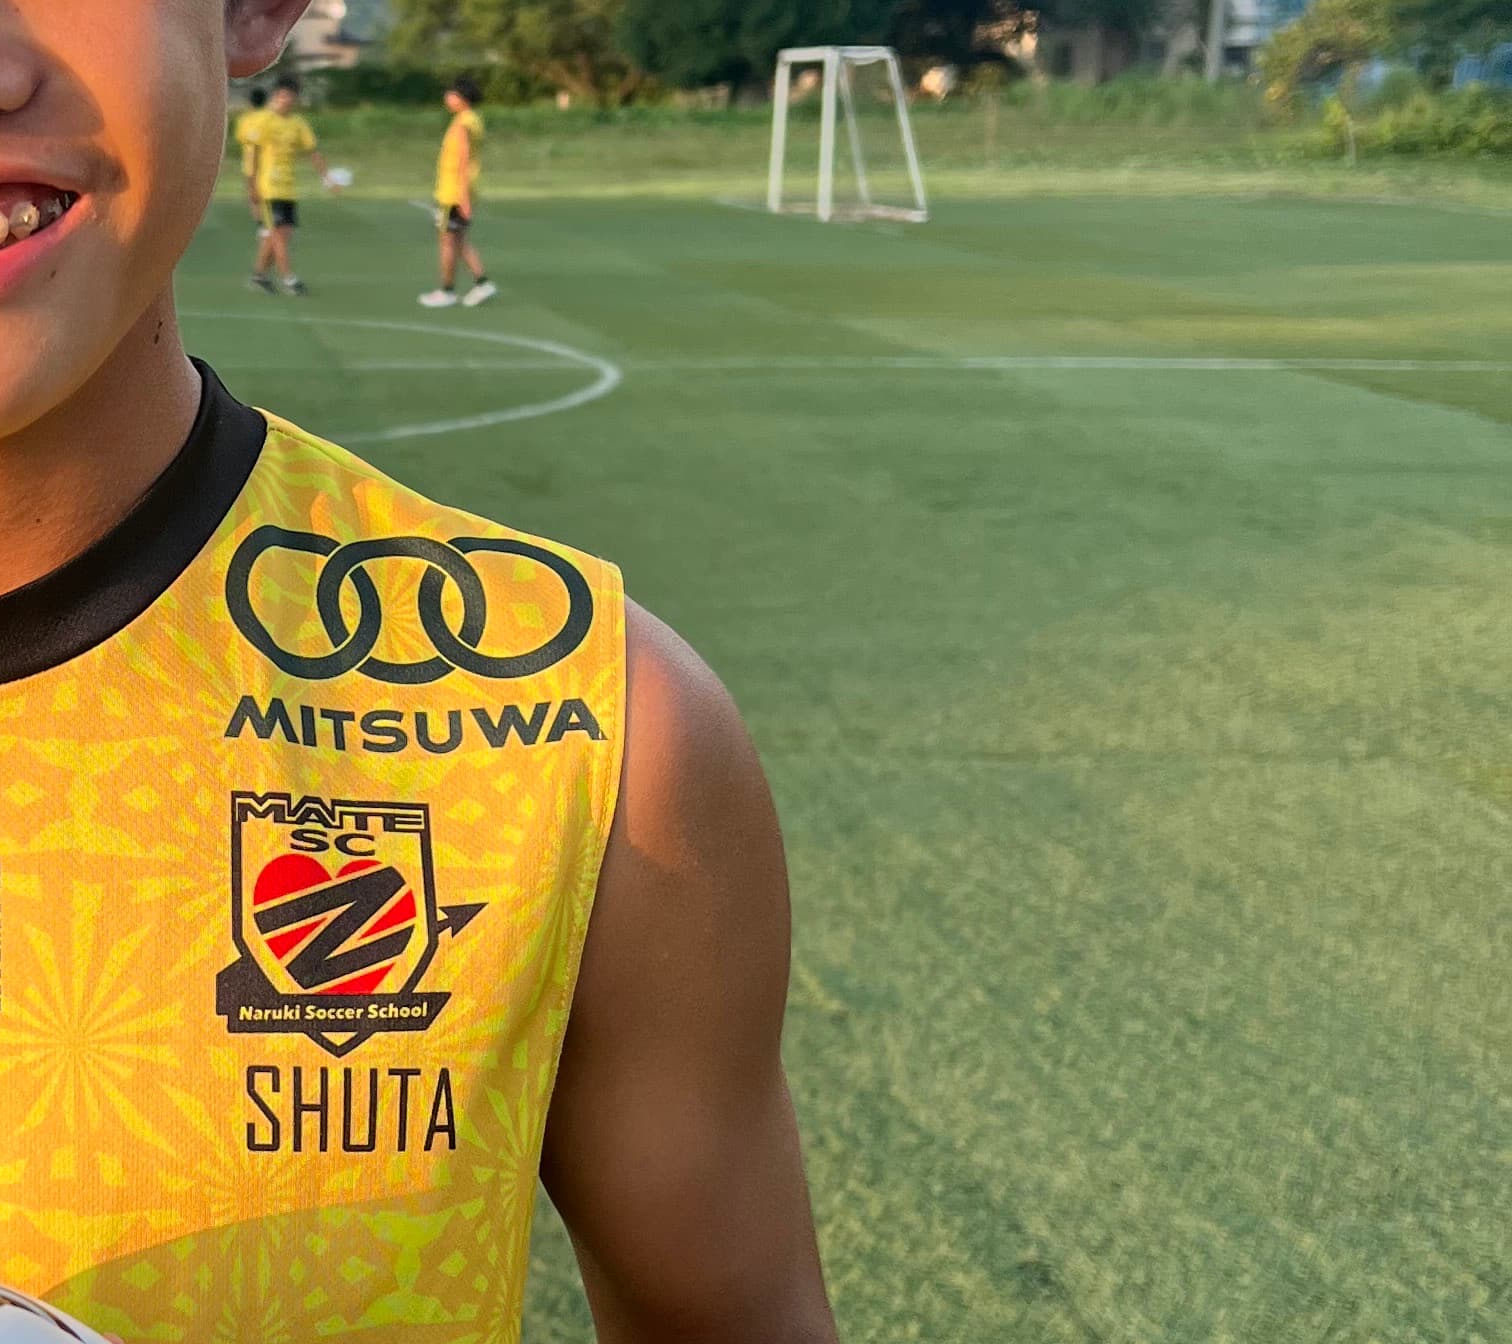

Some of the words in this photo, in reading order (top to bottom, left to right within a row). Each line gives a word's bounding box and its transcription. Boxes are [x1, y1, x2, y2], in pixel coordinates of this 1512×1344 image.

[224, 694, 608, 754] MITSUWA
[289, 828, 376, 857] SC
[238, 1005, 300, 1022] Naruki
[304, 1005, 364, 1020] Soccer
[367, 1001, 428, 1019] School
[245, 1065, 457, 1153] SHUTA
